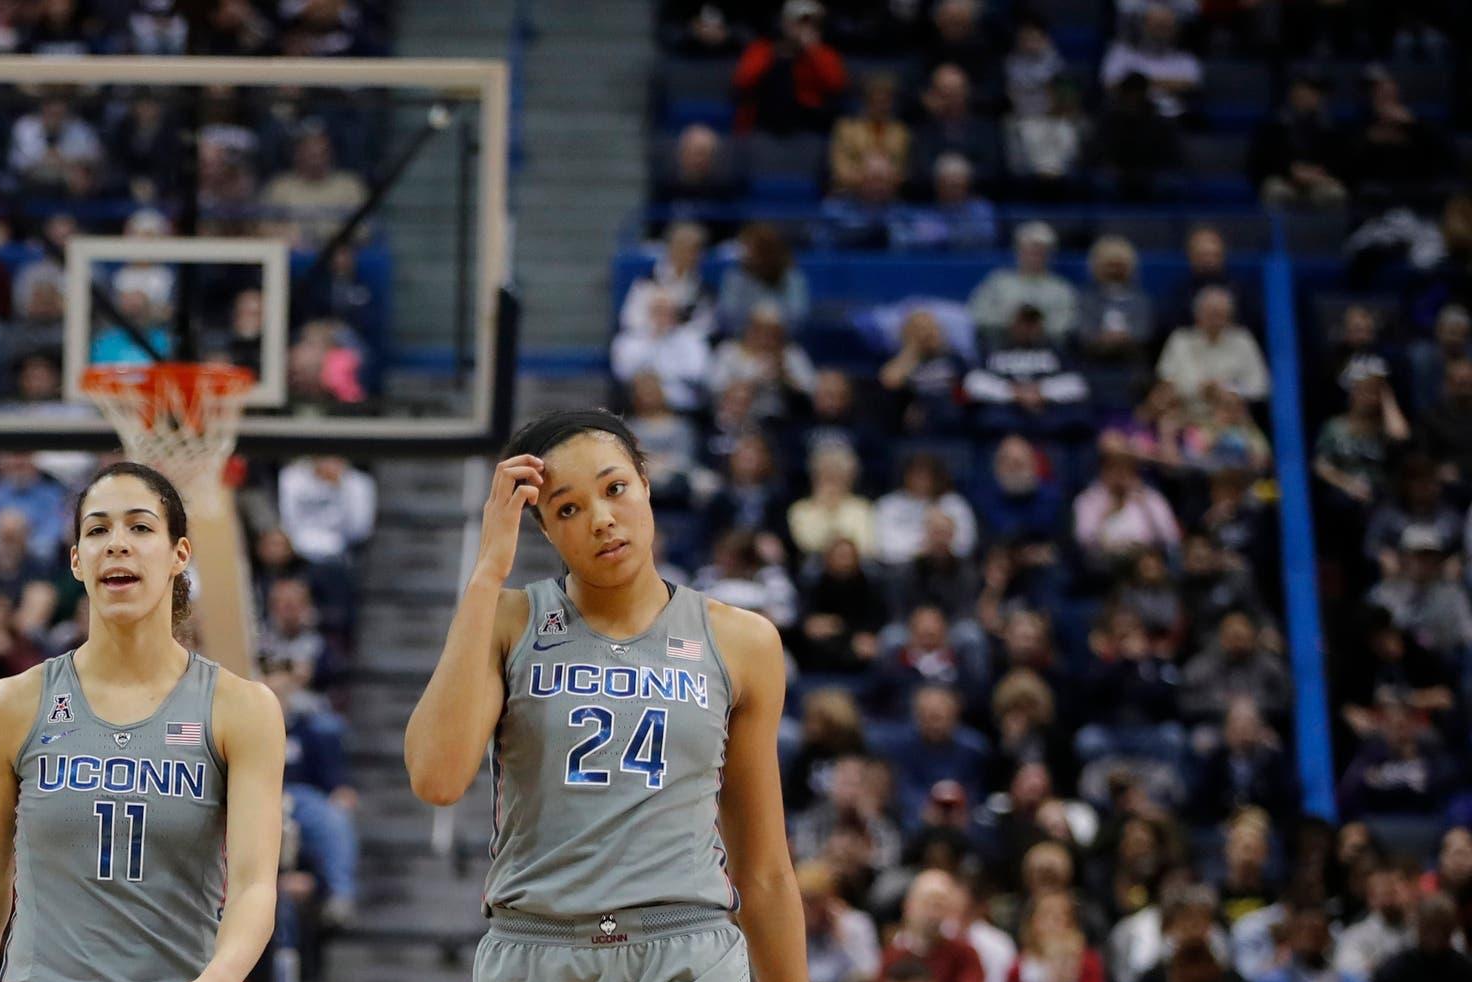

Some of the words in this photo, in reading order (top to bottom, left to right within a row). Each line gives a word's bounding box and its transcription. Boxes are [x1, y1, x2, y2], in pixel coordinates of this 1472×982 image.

[529, 663, 709, 709] UCONN
[565, 705, 669, 789] 24
[38, 755, 206, 799] UCONN
[94, 801, 148, 882] 11
[591, 934, 628, 945] UCONN
